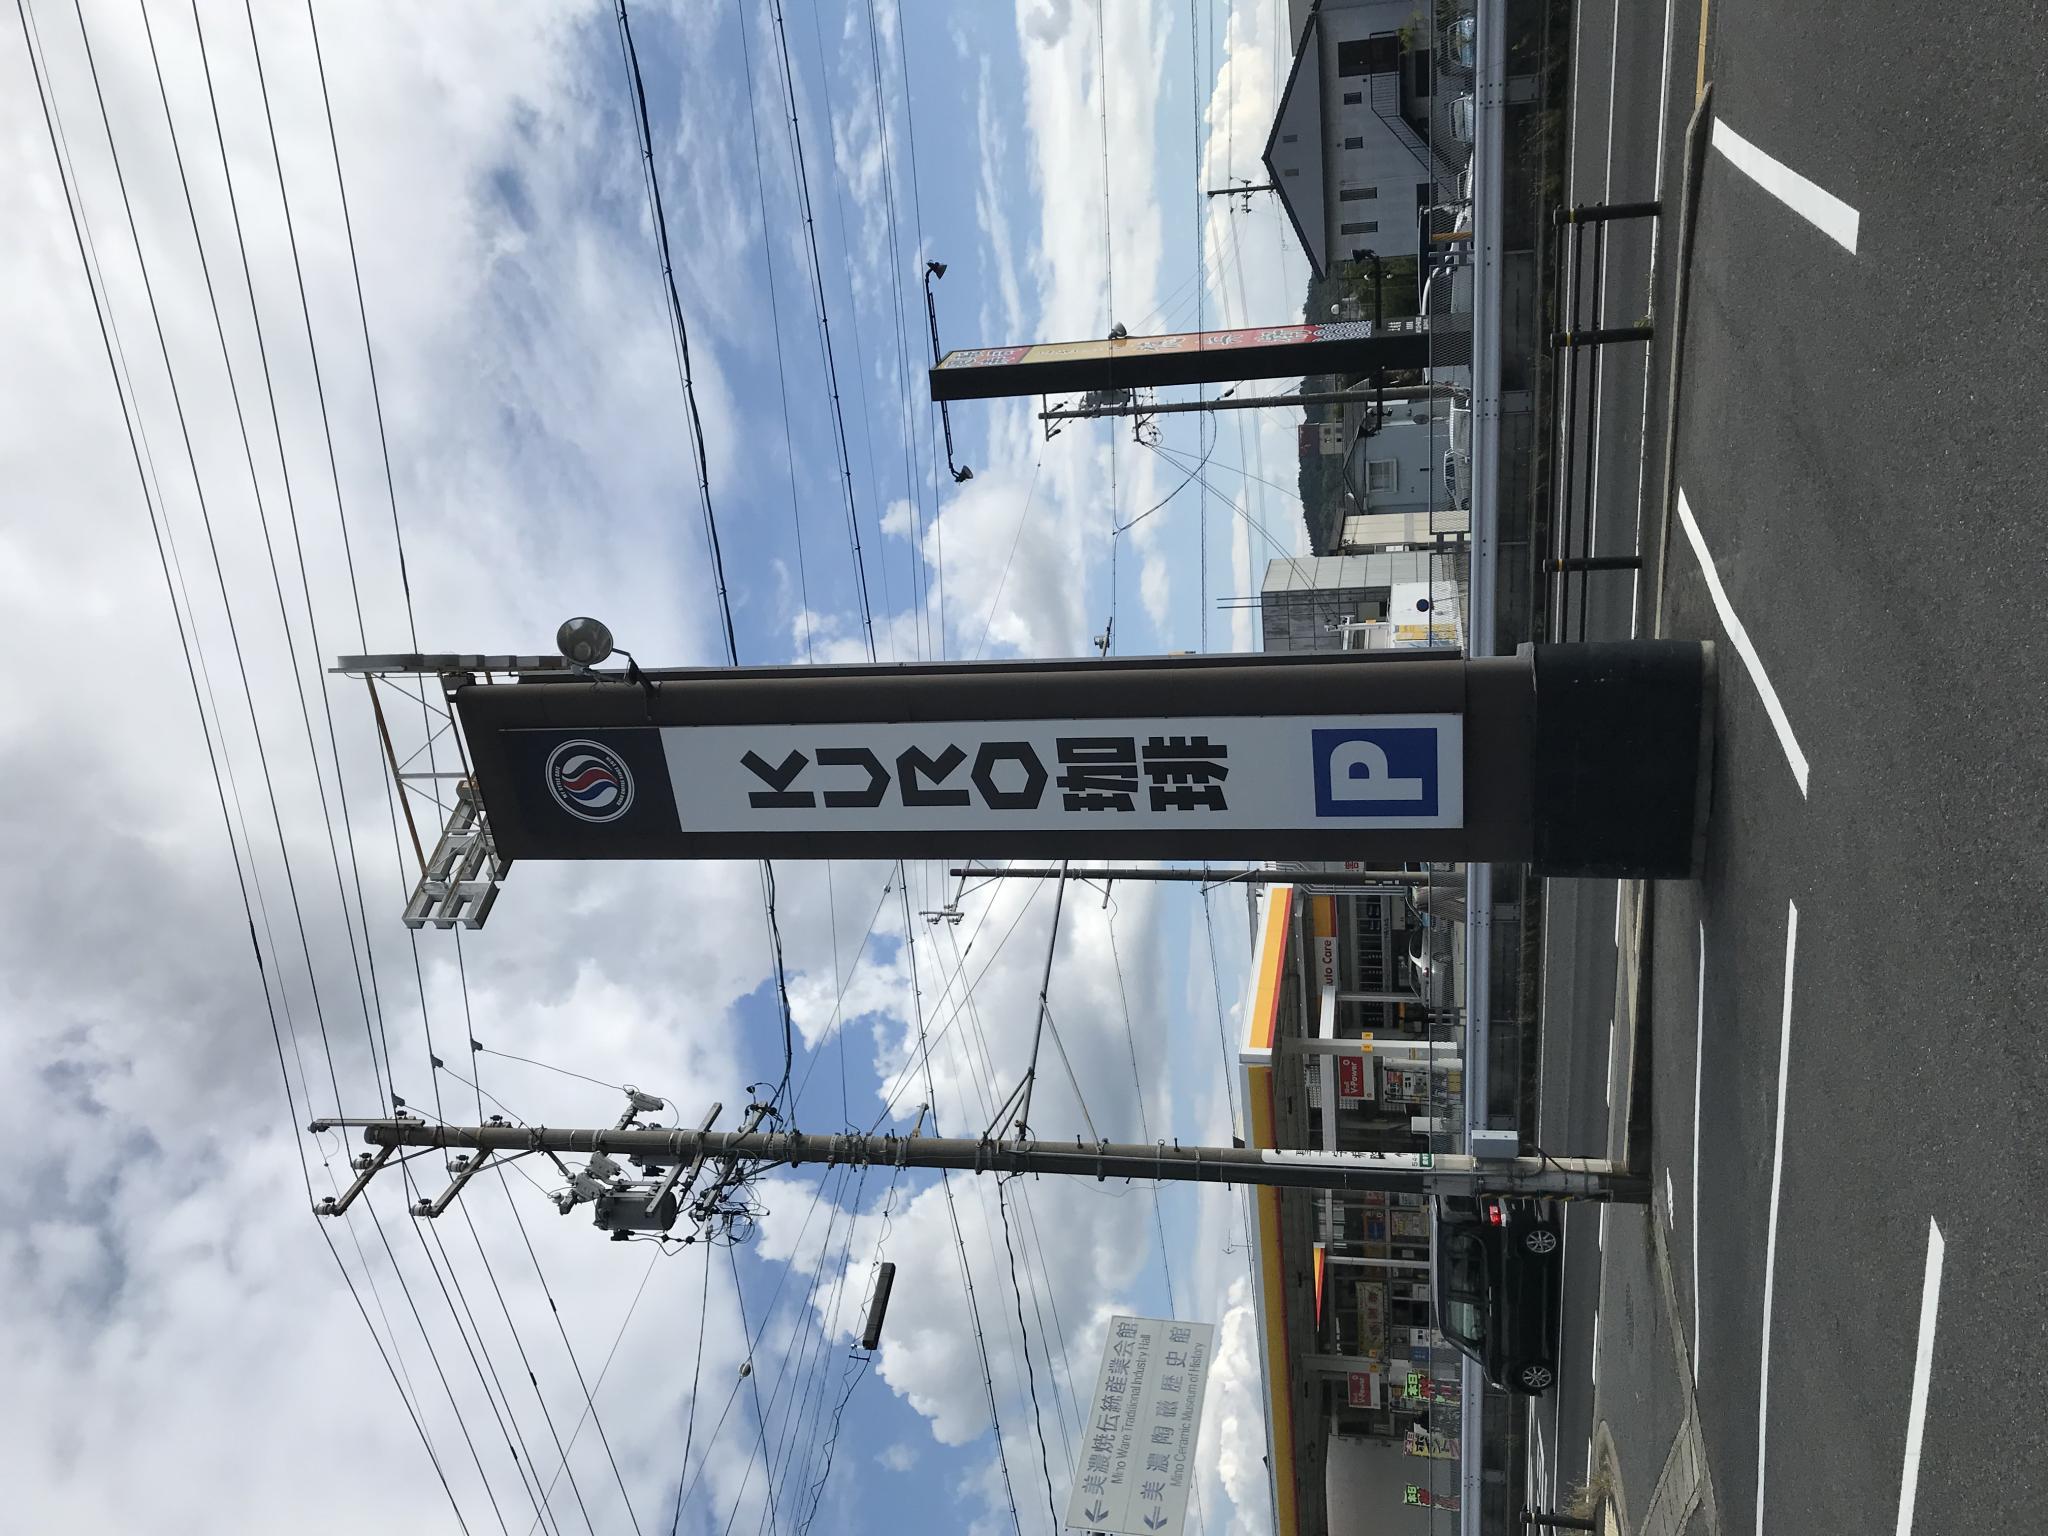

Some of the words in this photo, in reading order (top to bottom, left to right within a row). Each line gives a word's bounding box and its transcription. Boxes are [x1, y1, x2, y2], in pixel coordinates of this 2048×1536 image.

[1331, 740, 1422, 800] P
[1322, 940, 1332, 964] Care
[1324, 967, 1334, 986] uto
[1350, 1062, 1359, 1094] V-Power
[1138, 1334, 1150, 1350] Hall
[1130, 1351, 1150, 1385] Industry
[1189, 1342, 1206, 1372] History
[1188, 1373, 1198, 1382] of
[1407, 1374, 1418, 1396] 本日
[1082, 1322, 1138, 1495] 美濃焼伝統産業会館
[1122, 1386, 1142, 1432] Traditional
[1140, 1326, 1191, 1502] 美濃陶磁歴史館
[1180, 1384, 1197, 1421] Museum
[1116, 1434, 1131, 1459] Ware
[1174, 1422, 1192, 1462] Ceramic
[1111, 1461, 1126, 1484] Mino
[1170, 1464, 1185, 1486] Mino
[1407, 1486, 1417, 1502] 本日
